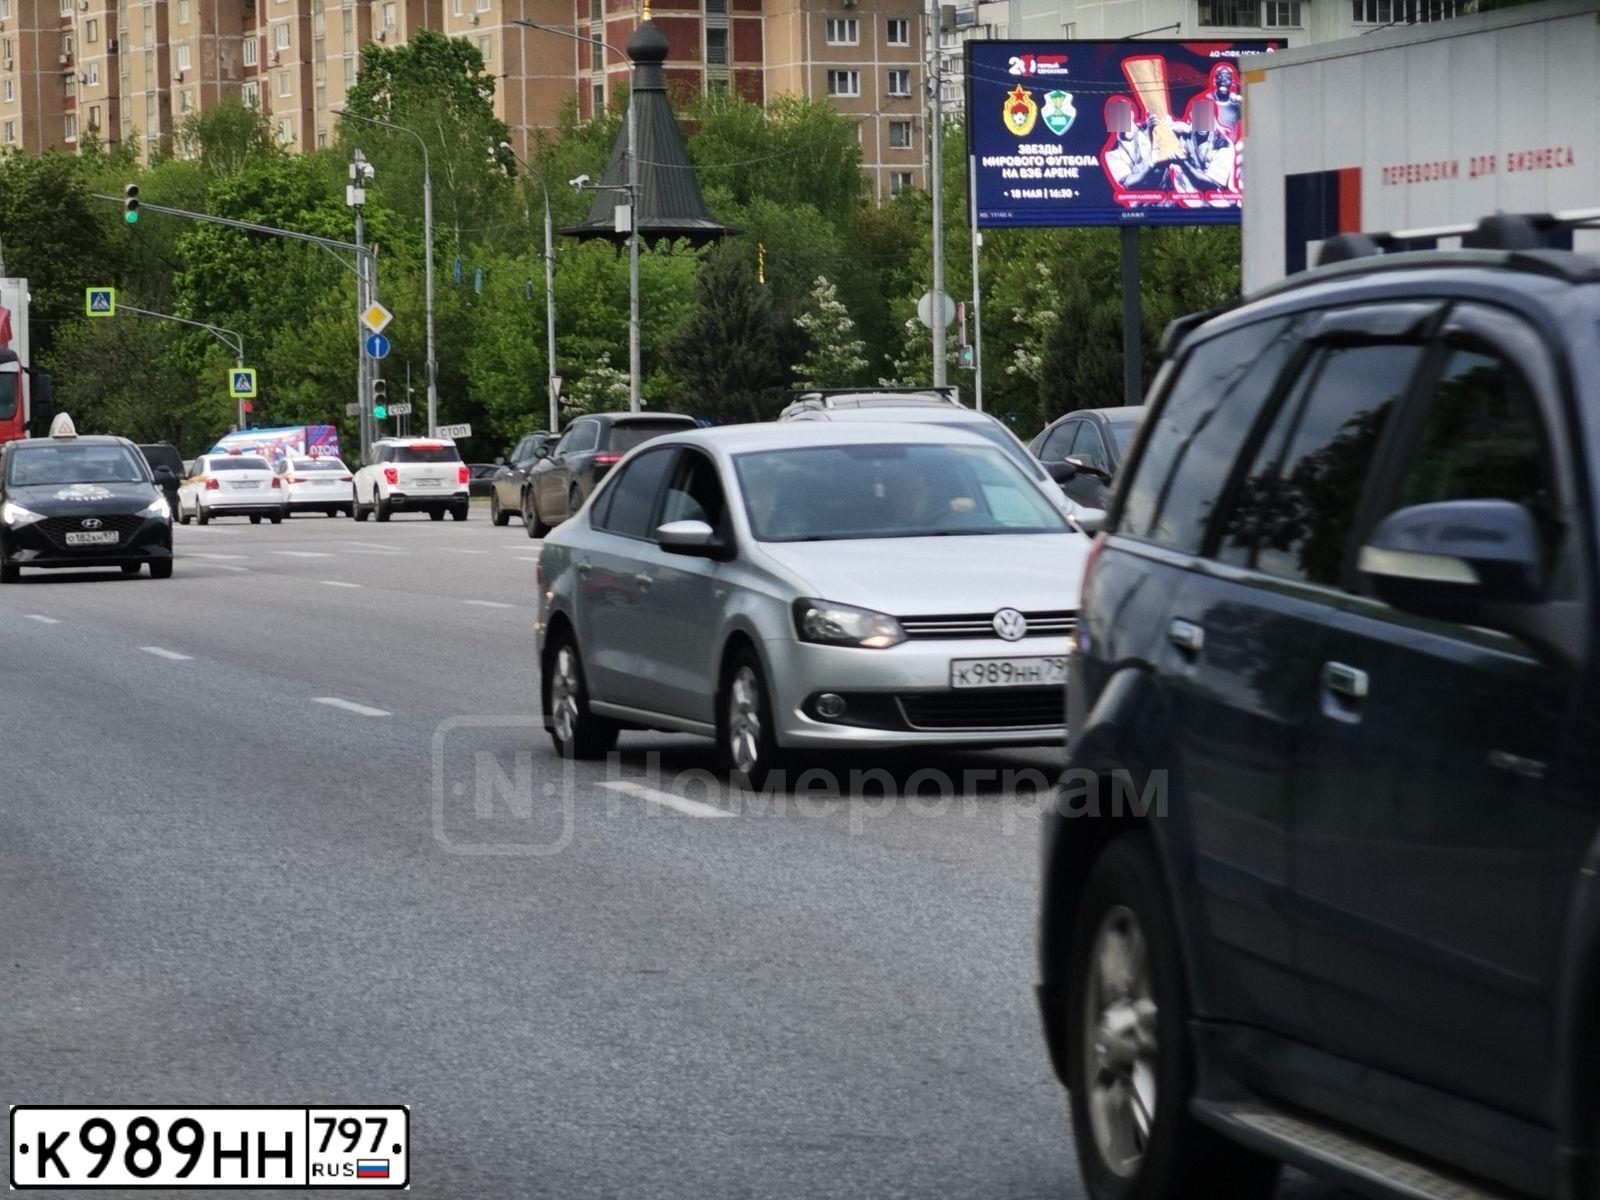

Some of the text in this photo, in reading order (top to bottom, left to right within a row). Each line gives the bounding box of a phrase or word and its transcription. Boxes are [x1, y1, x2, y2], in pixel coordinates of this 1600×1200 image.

[1018, 144, 1062, 155] ЗВЕЗДЫ
[982, 155, 1099, 167] МИРОВОГО ФУТБОЛА
[1382, 146, 1575, 186] ПЕРЕВОЗКИ ДЛЯ БИЗНЕСА
[1002, 168, 1079, 178] НА ВЭБ АРЕНЕ
[440, 426, 467, 437] СТОП
